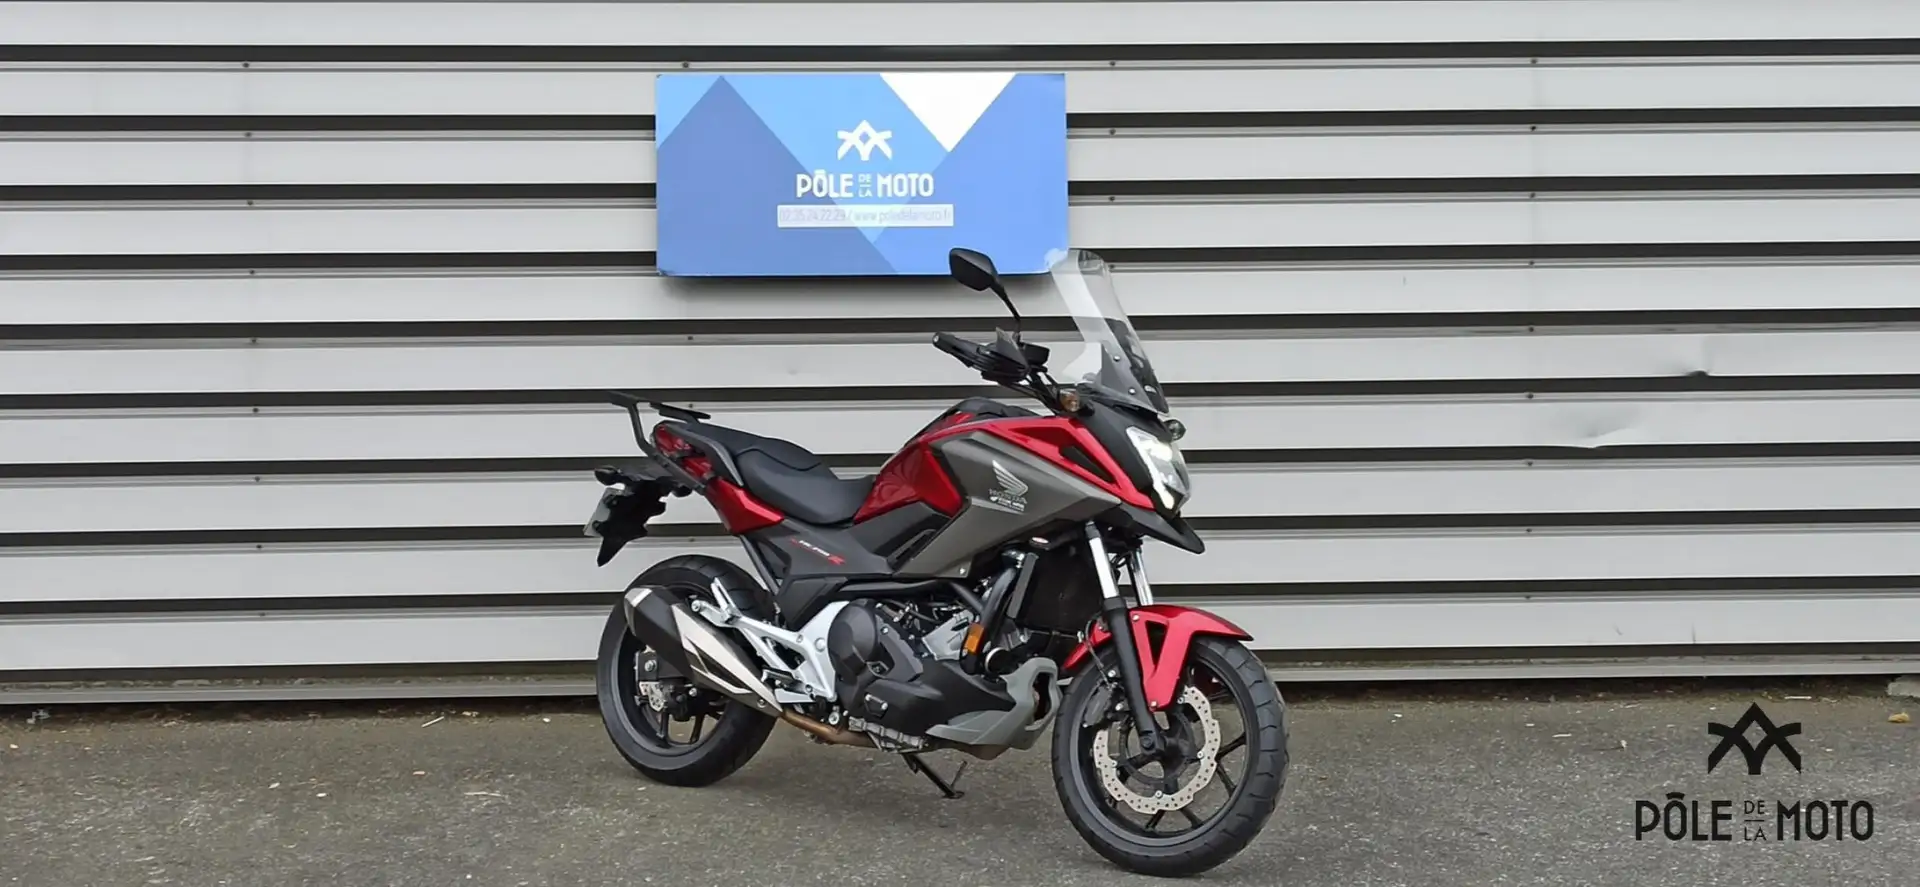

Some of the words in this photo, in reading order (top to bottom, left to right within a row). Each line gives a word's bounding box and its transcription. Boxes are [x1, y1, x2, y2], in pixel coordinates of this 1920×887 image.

[796, 169, 854, 198] PÔLE
[858, 174, 872, 182] DE
[877, 173, 934, 198] MOTO
[858, 189, 872, 197] LA
[988, 488, 1028, 504] HONDA
